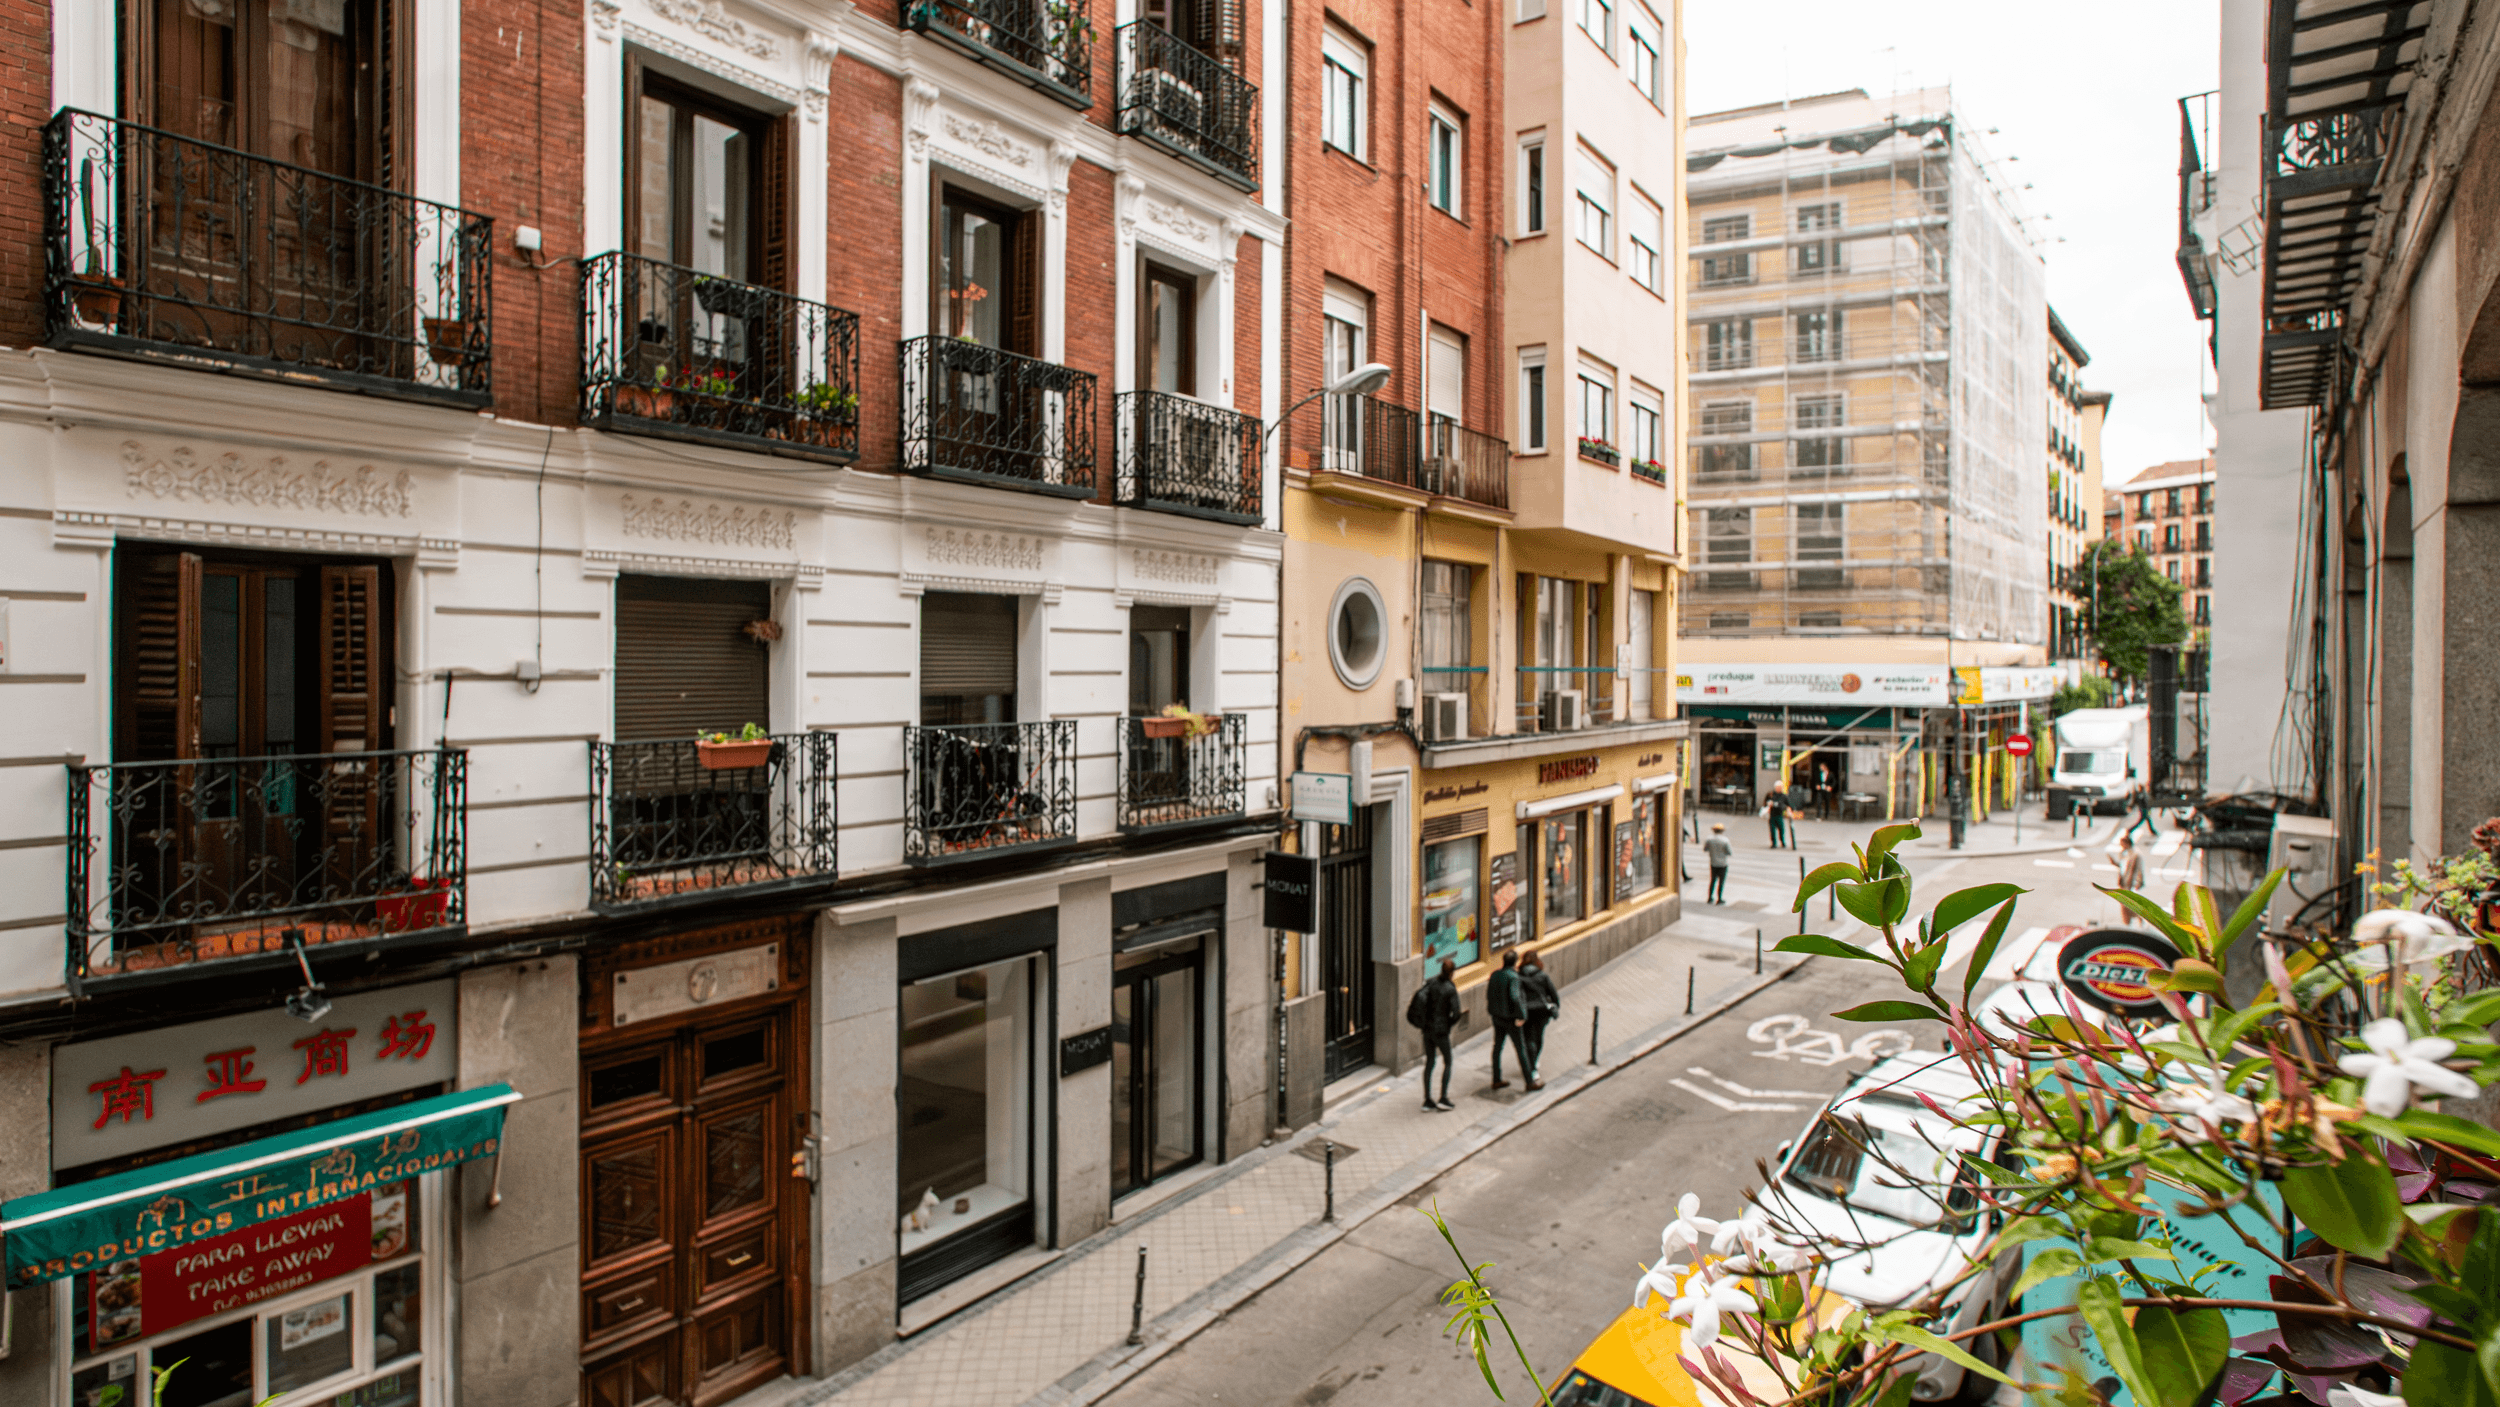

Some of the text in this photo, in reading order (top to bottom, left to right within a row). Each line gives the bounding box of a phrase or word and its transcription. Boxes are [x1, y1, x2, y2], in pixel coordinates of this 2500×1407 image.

[1267, 879, 1309, 896] MONAT
[2083, 962, 2147, 982] Dicki
[1065, 1032, 1107, 1055] MONAT
[89, 1011, 436, 1129] 南亚商场
[175, 1213, 344, 1278] PARA LLEVAR
[187, 1266, 256, 1302] TAKE
[264, 1241, 335, 1278] AWAY
